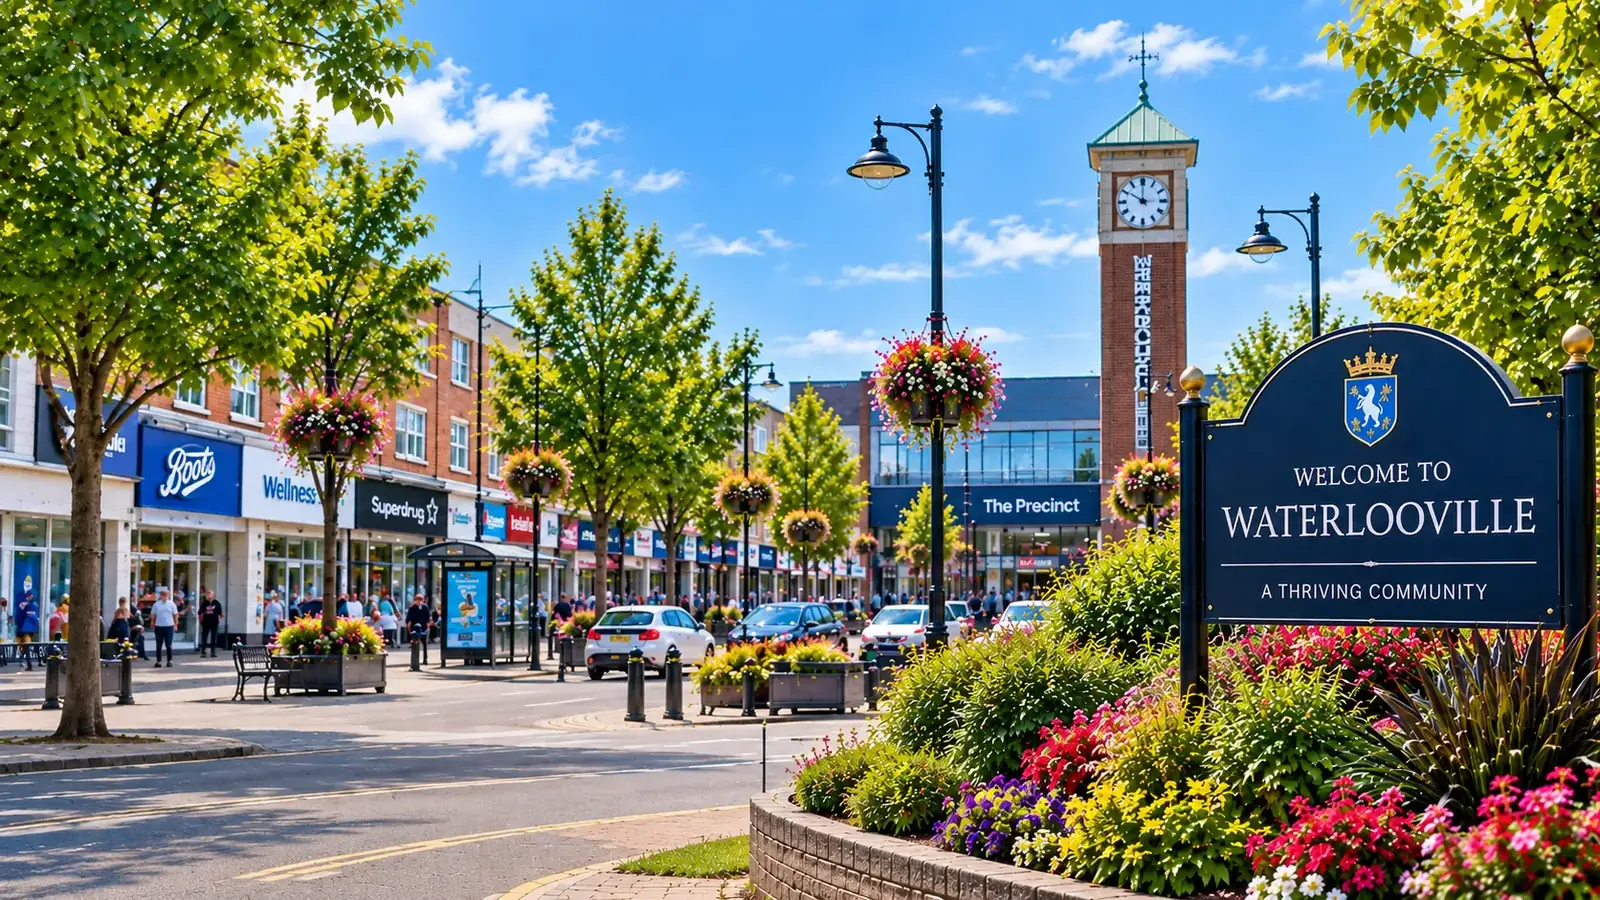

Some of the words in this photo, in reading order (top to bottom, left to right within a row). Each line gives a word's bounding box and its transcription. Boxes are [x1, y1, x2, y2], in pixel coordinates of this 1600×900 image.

[160, 444, 216, 498] Boots
[1293, 464, 1409, 487] WELCOME
[1417, 460, 1451, 482] TO
[263, 474, 317, 504] Wellness
[371, 495, 425, 525] Superdrug
[983, 498, 1012, 513] The
[1016, 497, 1080, 513] Precinct
[1222, 497, 1536, 538] WATERLOOVILLE
[1261, 584, 1272, 599] A
[1278, 584, 1361, 600] THRIVING
[1369, 583, 1488, 600] COMMUNITY
